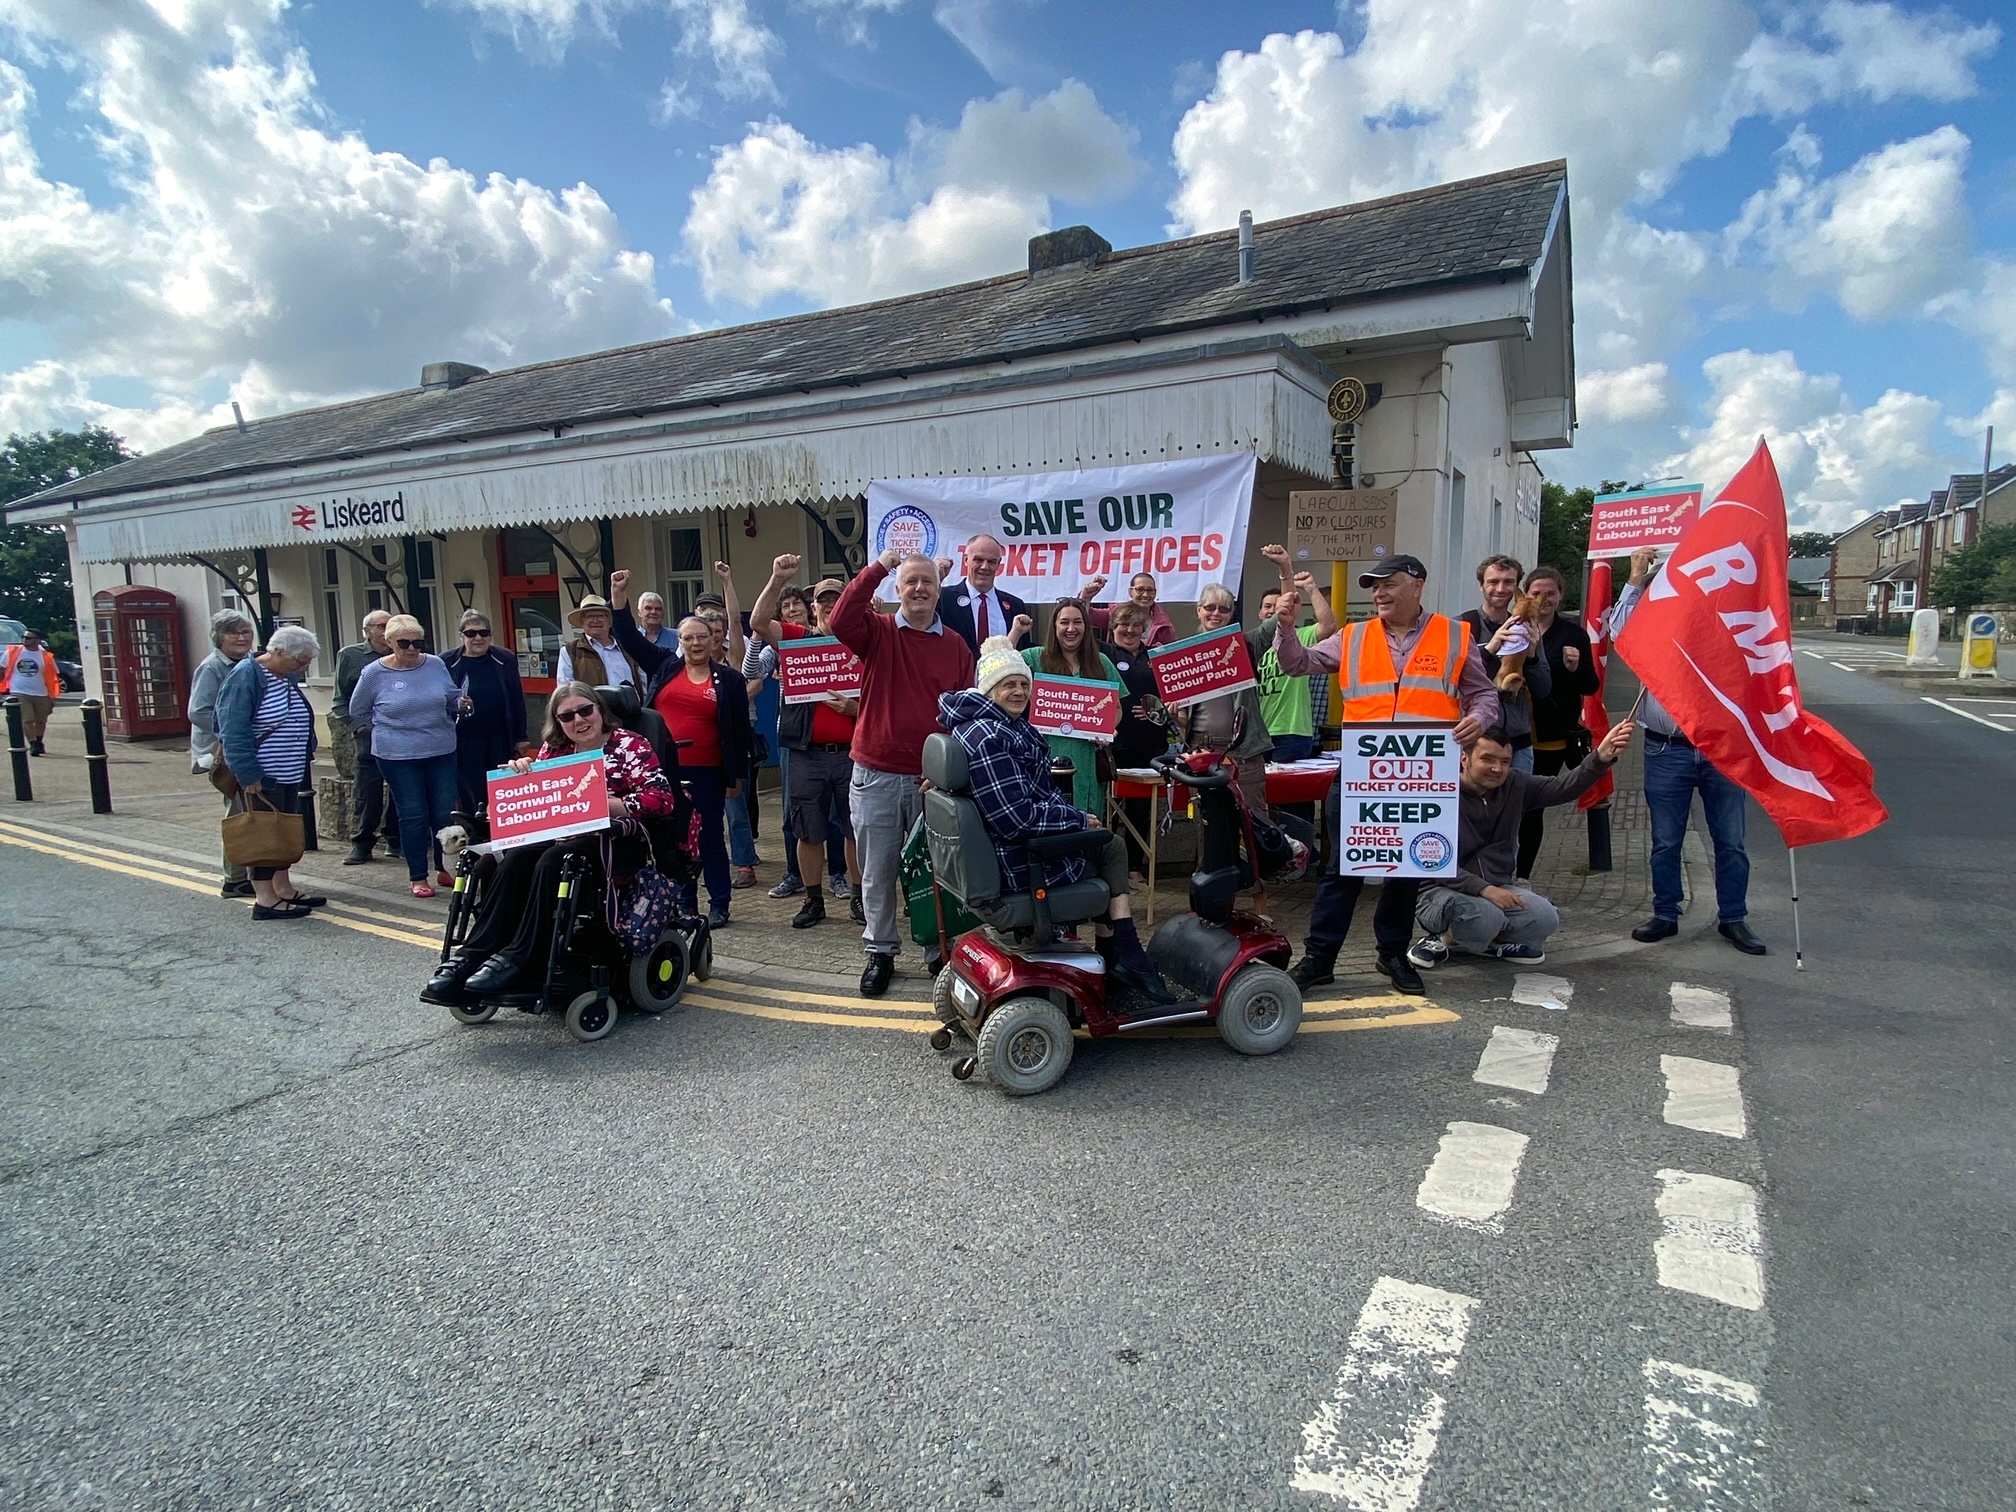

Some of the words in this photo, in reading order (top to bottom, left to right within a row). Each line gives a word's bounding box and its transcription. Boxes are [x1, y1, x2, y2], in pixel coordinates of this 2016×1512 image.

[321, 491, 405, 529] Liskeard
[1299, 496, 1356, 510] LABOUR
[884, 507, 909, 524] SAFETY
[1000, 499, 1087, 537] SAVE
[1099, 493, 1174, 532] OUR
[1598, 508, 1638, 520] South
[1640, 503, 1671, 515] East
[892, 522, 920, 532] SAVE
[1296, 515, 1313, 528] NO
[1315, 516, 1328, 529] TO
[1330, 515, 1387, 529] CLOSURES
[1597, 516, 1657, 530] Cornwall
[1297, 534, 1318, 545] PAY
[1321, 534, 1339, 544] THE
[1596, 529, 1642, 541] Labour
[1644, 525, 1682, 537] Party
[891, 539, 920, 547] TICKET
[958, 543, 1068, 576] TCKET
[1079, 533, 1224, 575] OFFICES
[785, 654, 820, 665] South
[822, 652, 847, 662] East
[1158, 656, 1193, 672] South
[1195, 648, 1221, 661] East
[787, 663, 838, 675] Cornwall
[1161, 661, 1213, 683] Cornwall
[788, 677, 827, 687] Labour
[830, 673, 860, 682] Party
[1164, 676, 1204, 694] Labour
[1206, 667, 1238, 681] Party
[1037, 688, 1069, 699] South
[1071, 692, 1095, 702] East
[1036, 698, 1084, 711] Cornwall
[1034, 708, 1072, 720] Labour
[1074, 713, 1103, 726] Party
[1357, 735, 1445, 757] SAVE
[1372, 760, 1430, 779] OUR
[495, 782, 539, 800] South
[541, 775, 574, 791] East
[1345, 782, 1395, 792] TICKET
[1398, 782, 1456, 792] OFFICES
[496, 790, 562, 814] Cornwall
[497, 809, 548, 827] Labour
[551, 800, 591, 817] Party
[1359, 802, 1442, 824] KEEP
[1350, 826, 1399, 836] TICKET
[504, 837, 526, 846] Labour
[1346, 837, 1404, 847] OFFICES
[1346, 849, 1403, 863] OPEN
